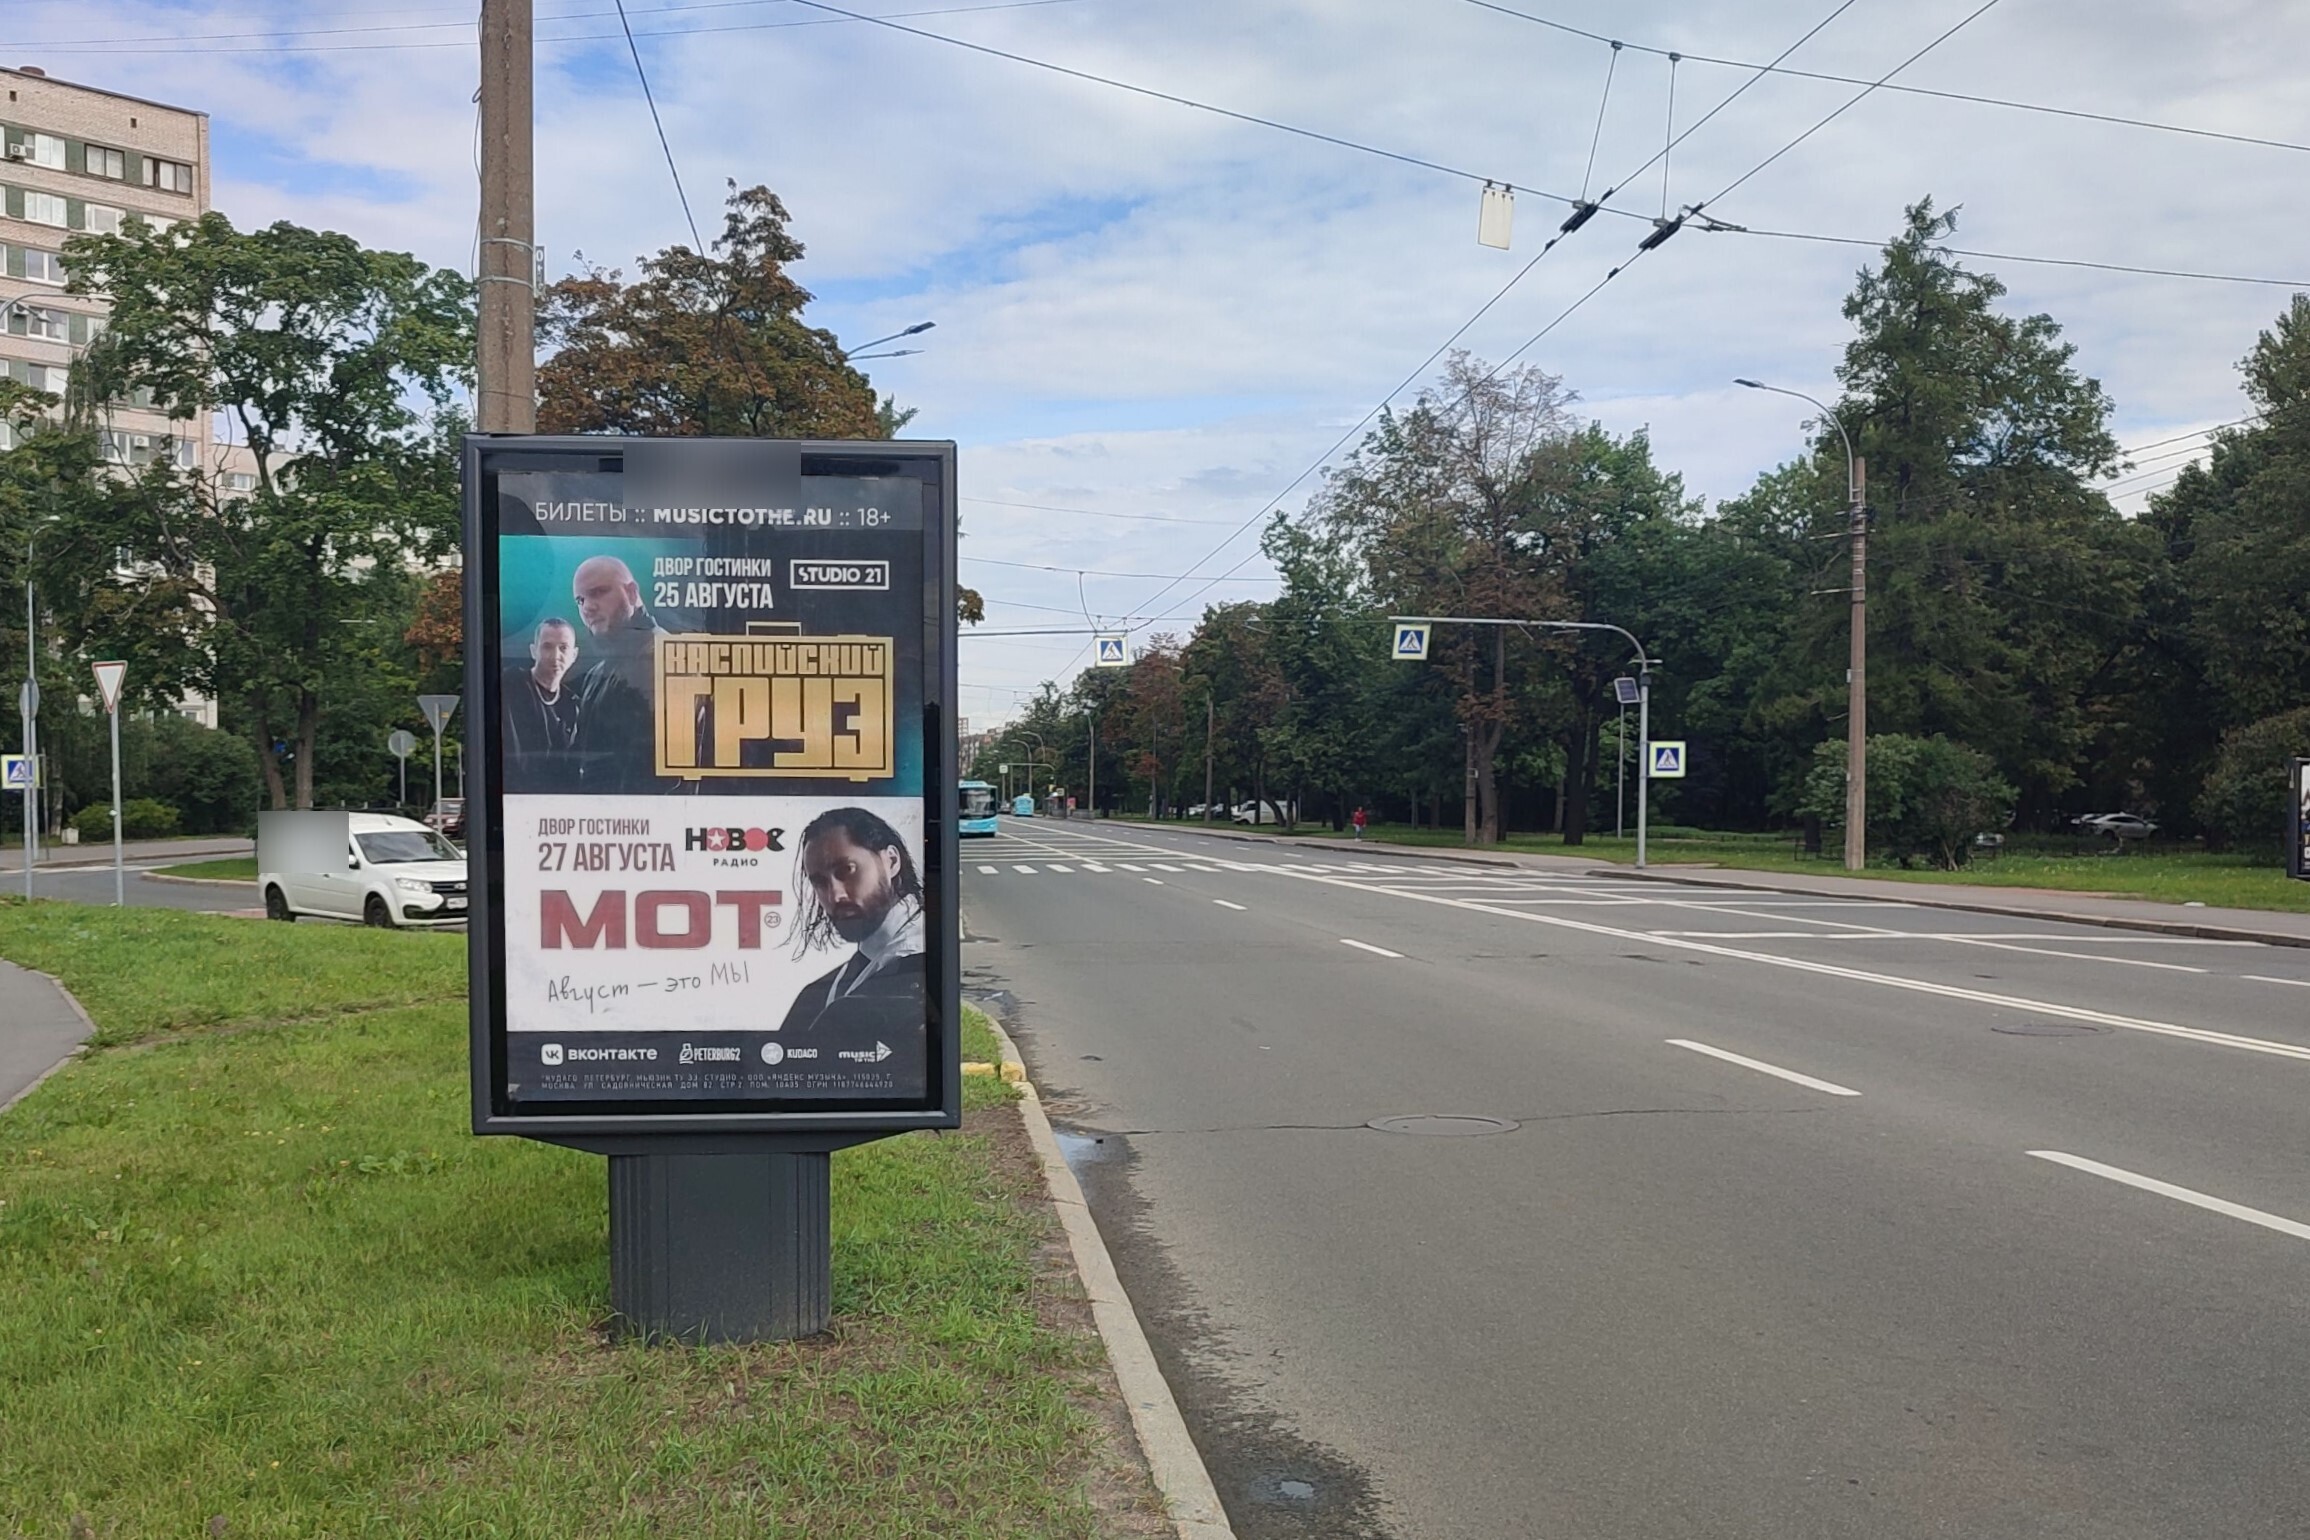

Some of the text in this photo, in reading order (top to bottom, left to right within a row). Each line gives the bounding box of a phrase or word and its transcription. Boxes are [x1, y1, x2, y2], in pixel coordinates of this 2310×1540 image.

[535, 502, 627, 522] БИЛЕТЫ
[857, 508, 892, 527] 18+
[653, 557, 772, 578] ДВОР ГОСТИНКИ
[798, 566, 883, 583] STUDIO 21
[653, 582, 775, 609] 25 АВГУСТА
[665, 643, 884, 676] КАСПИЙСКИЙ
[666, 676, 884, 768] ГРУЗ
[538, 818, 650, 837] ДВОР ГОСТИНКИ
[538, 842, 676, 872] 27 АВГУСТА
[713, 858, 758, 867] РАДИО
[540, 890, 783, 950] МОТ
[548, 975, 629, 1013] Август
[665, 977, 701, 992] это
[786, 1048, 818, 1059] KUDAGO
